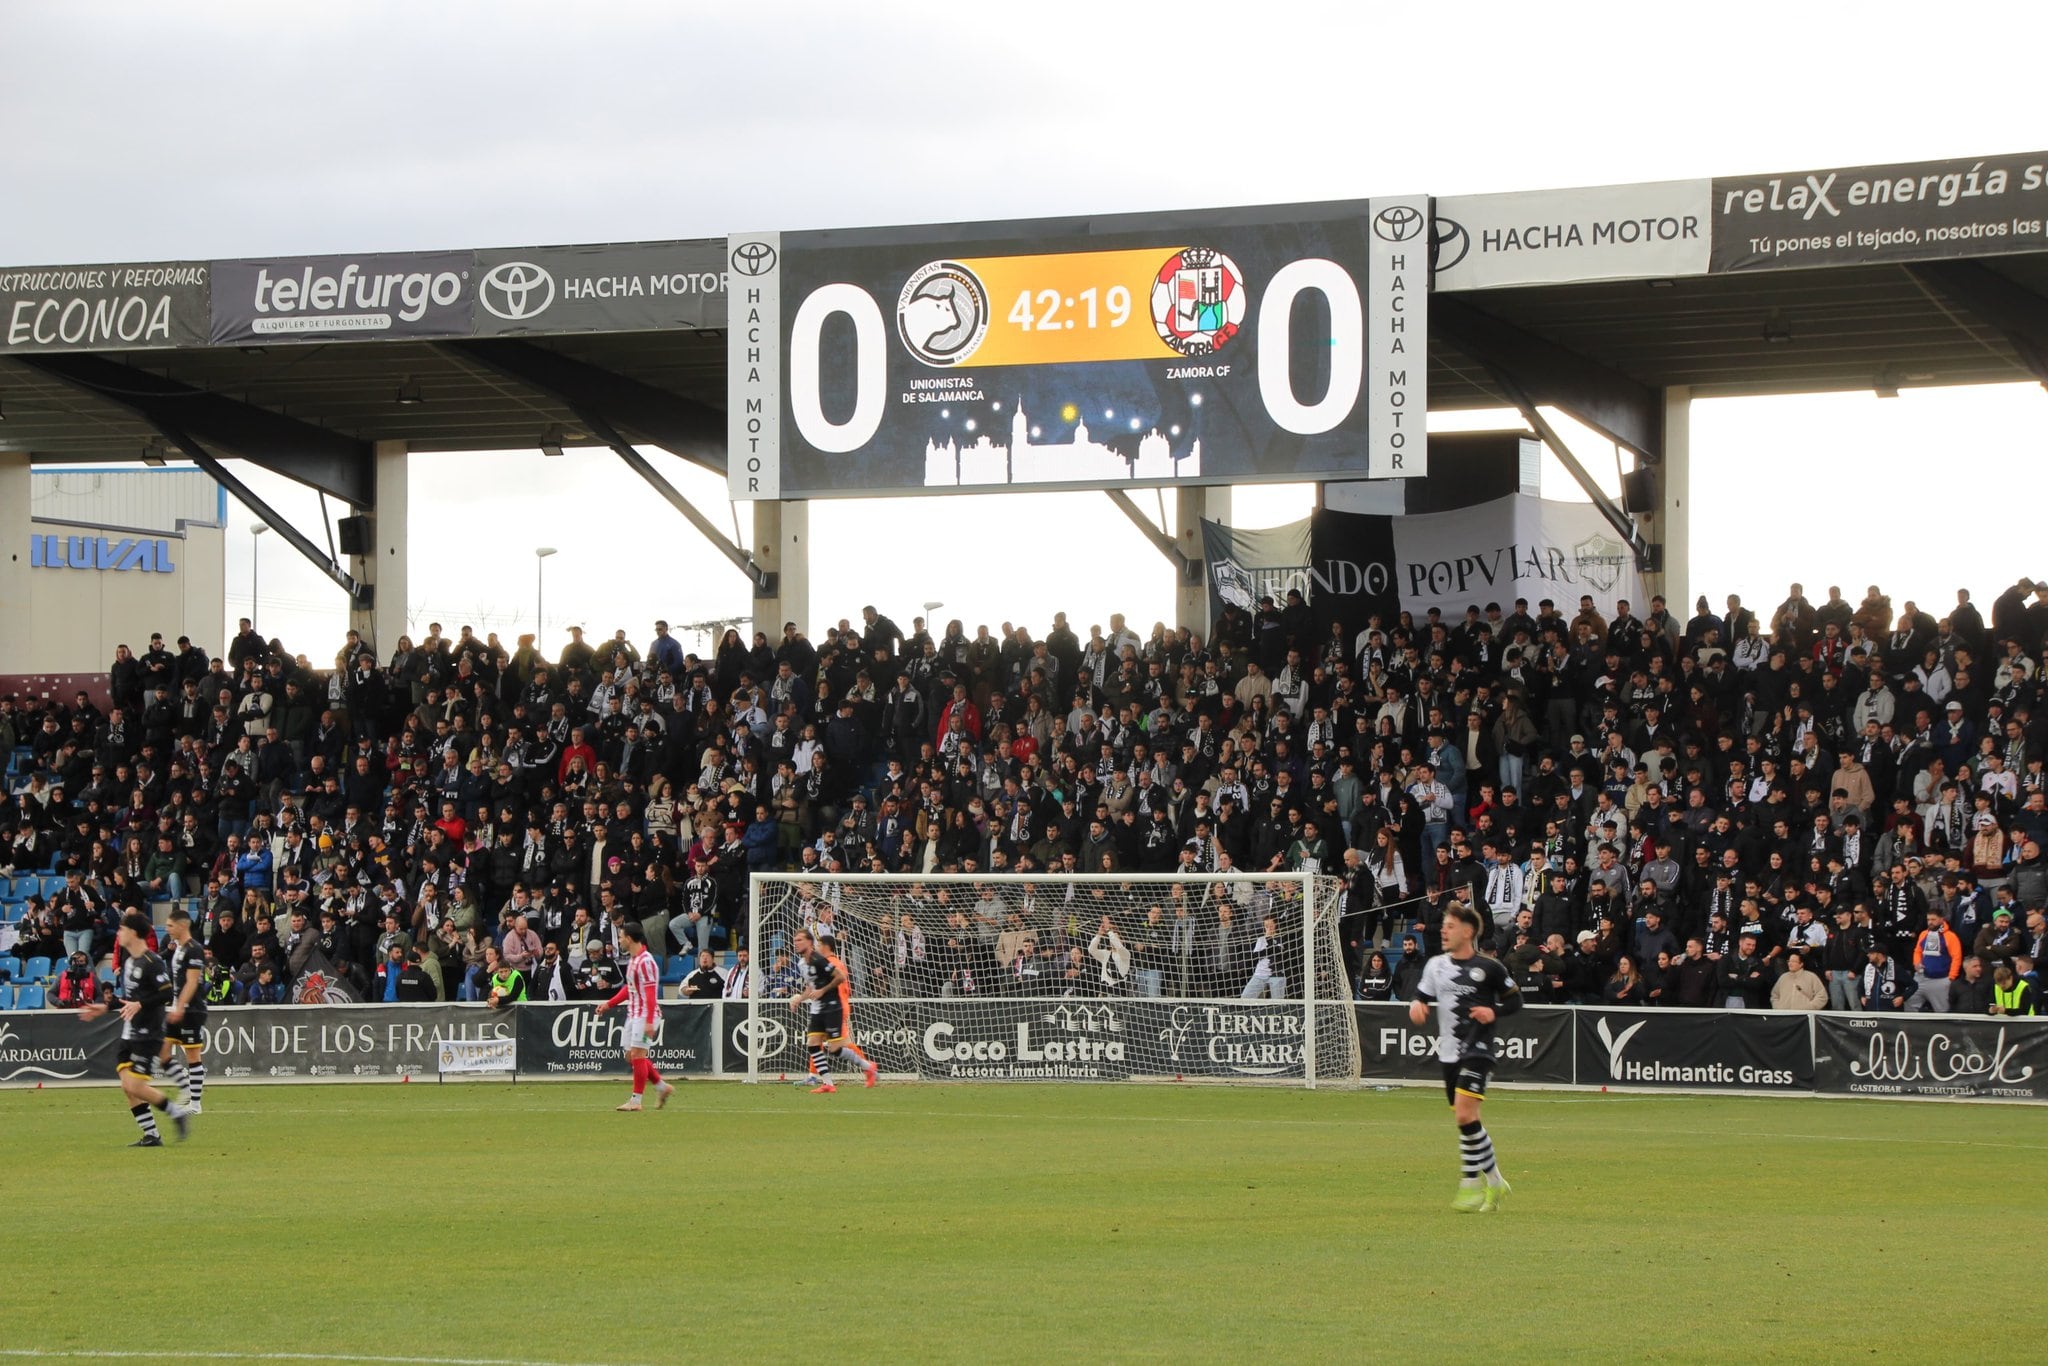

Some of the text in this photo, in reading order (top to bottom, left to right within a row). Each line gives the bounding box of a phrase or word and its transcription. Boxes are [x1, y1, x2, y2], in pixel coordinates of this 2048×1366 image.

[1723, 162, 2048, 220] relaX energía s
[1482, 215, 1699, 252] HACHA MOTOR
[1749, 237, 1771, 253] Tú
[1775, 237, 1832, 256] pones
[1835, 231, 1851, 247] el
[1856, 226, 1921, 250] tejado,
[1926, 221, 2008, 242] nosotros
[2012, 218, 2041, 235] las
[0, 267, 206, 292] STRUCCIONES Y REFORMAS
[564, 272, 728, 299] HACHA MOTOR
[254, 264, 461, 322] telefurgo
[8, 295, 171, 345] ECONOA
[1007, 285, 1132, 332] 42:19
[260, 317, 384, 330] ALQUILER DE FURGONETAS
[1257, 258, 1363, 435] 0
[790, 283, 887, 454] 0
[1166, 365, 1231, 379] ZAMORA CF
[1389, 254, 1406, 469] HACHA MOTOR
[746, 288, 762, 492] HACHA MOTOR
[910, 377, 974, 390] UNIONISTAS
[902, 390, 985, 403] DE SALAMANCA
[1849, 1019, 1878, 1028] GRUPO
[270, 1025, 308, 1054] DE
[321, 1024, 375, 1053] LOS
[857, 1030, 918, 1046] MOTOR
[923, 1021, 1125, 1061] Coco Lastra
[0, 1047, 87, 1062] ARDAGUILA
[455, 1044, 513, 1058] VERSUS
[568, 1049, 619, 1059] PREVENCION
[657, 1049, 697, 1059] LABORAL
[950, 1064, 1098, 1078] Asesora Inmobiliaria
[1626, 1060, 1793, 1085] Helmantic Grass
[1850, 1083, 2033, 1097] GASTROBAR VERMUTERÍA EVENTOS
